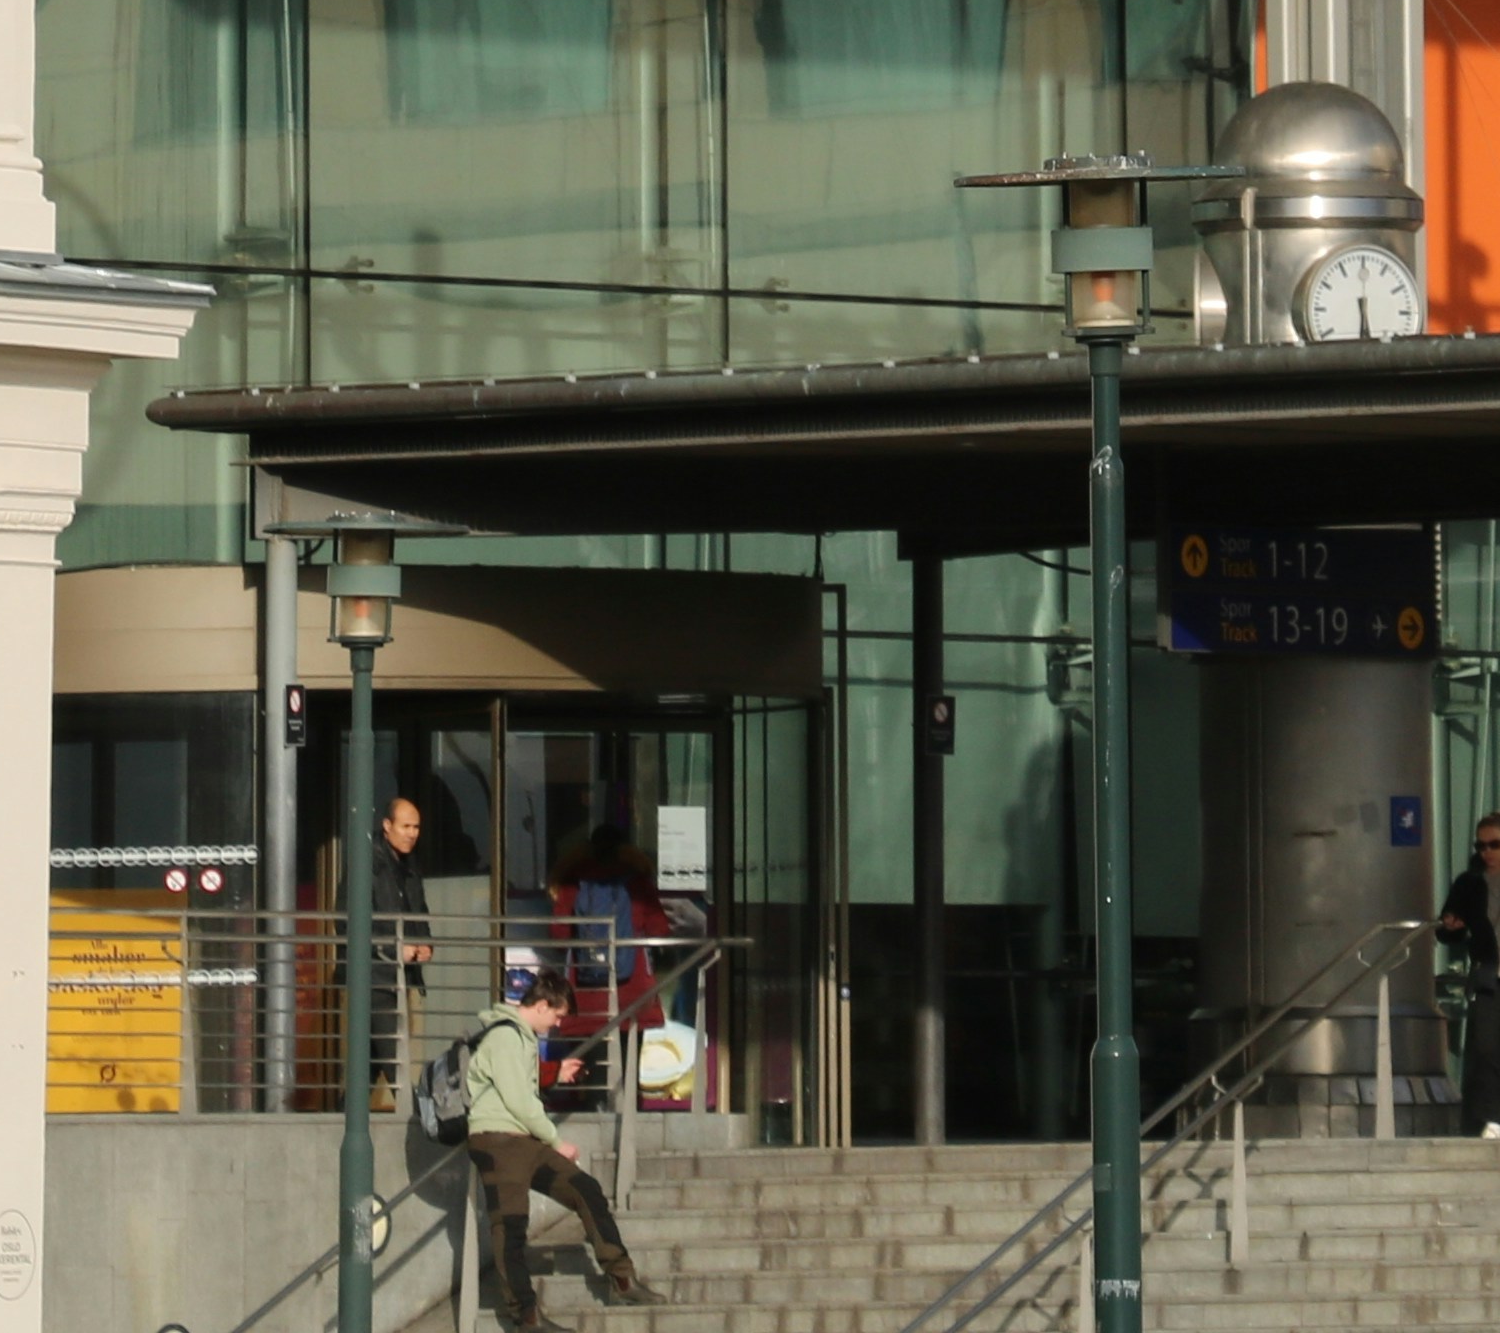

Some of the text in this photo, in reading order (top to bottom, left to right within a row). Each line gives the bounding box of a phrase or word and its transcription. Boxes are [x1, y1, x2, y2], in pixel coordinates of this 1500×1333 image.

[1219, 532, 1330, 580] Spor 1-12
[1220, 558, 1258, 579] Track
[1220, 598, 1349, 646] Spor 13-19
[1220, 622, 1259, 643] Track
